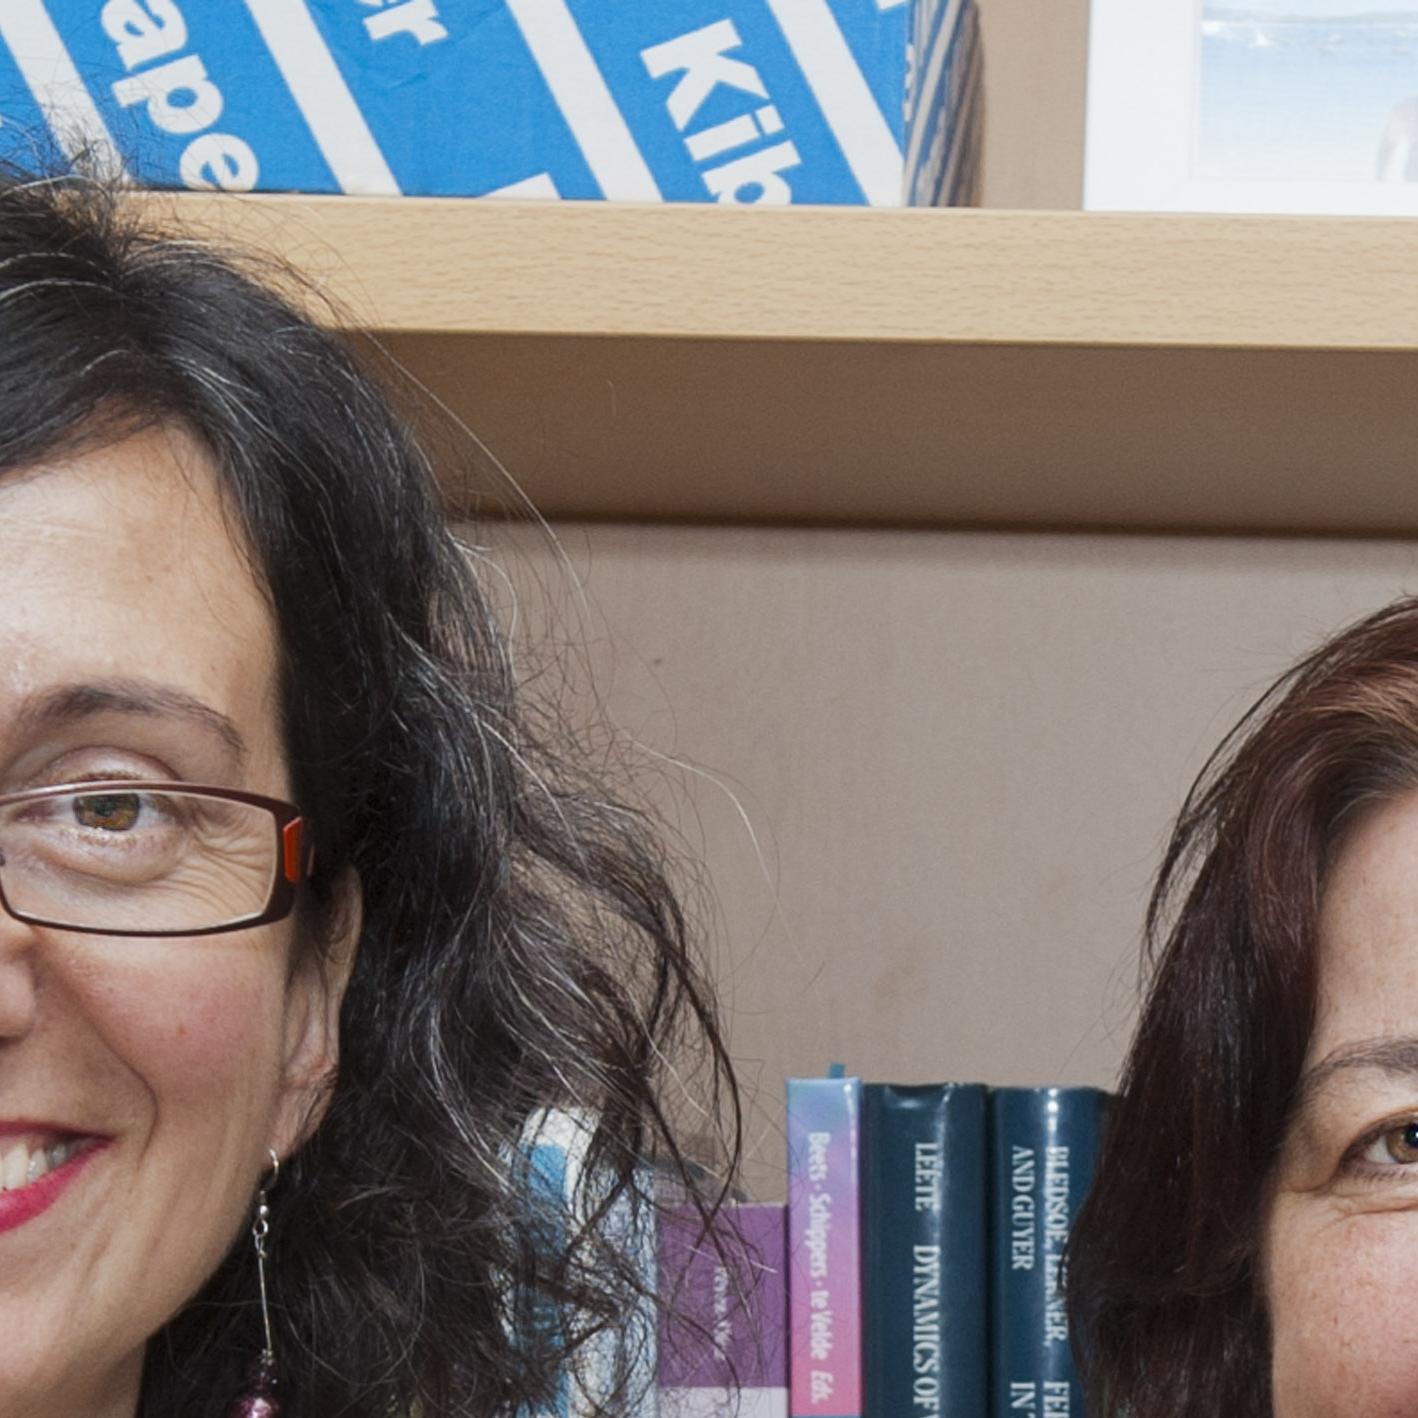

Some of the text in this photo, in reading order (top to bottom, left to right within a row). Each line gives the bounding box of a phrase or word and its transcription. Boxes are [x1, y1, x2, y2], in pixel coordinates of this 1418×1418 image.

[807, 1131, 831, 1181] Beets
[914, 1142, 939, 1211] LEETE
[804, 1192, 832, 1279] Schippers
[1011, 1146, 1035, 1270] AND GUYER
[810, 1310, 833, 1360] Velde
[913, 1245, 941, 1373] DYNAMICS
[913, 1377, 941, 1411] OF
[1009, 1381, 1036, 1408] IN
